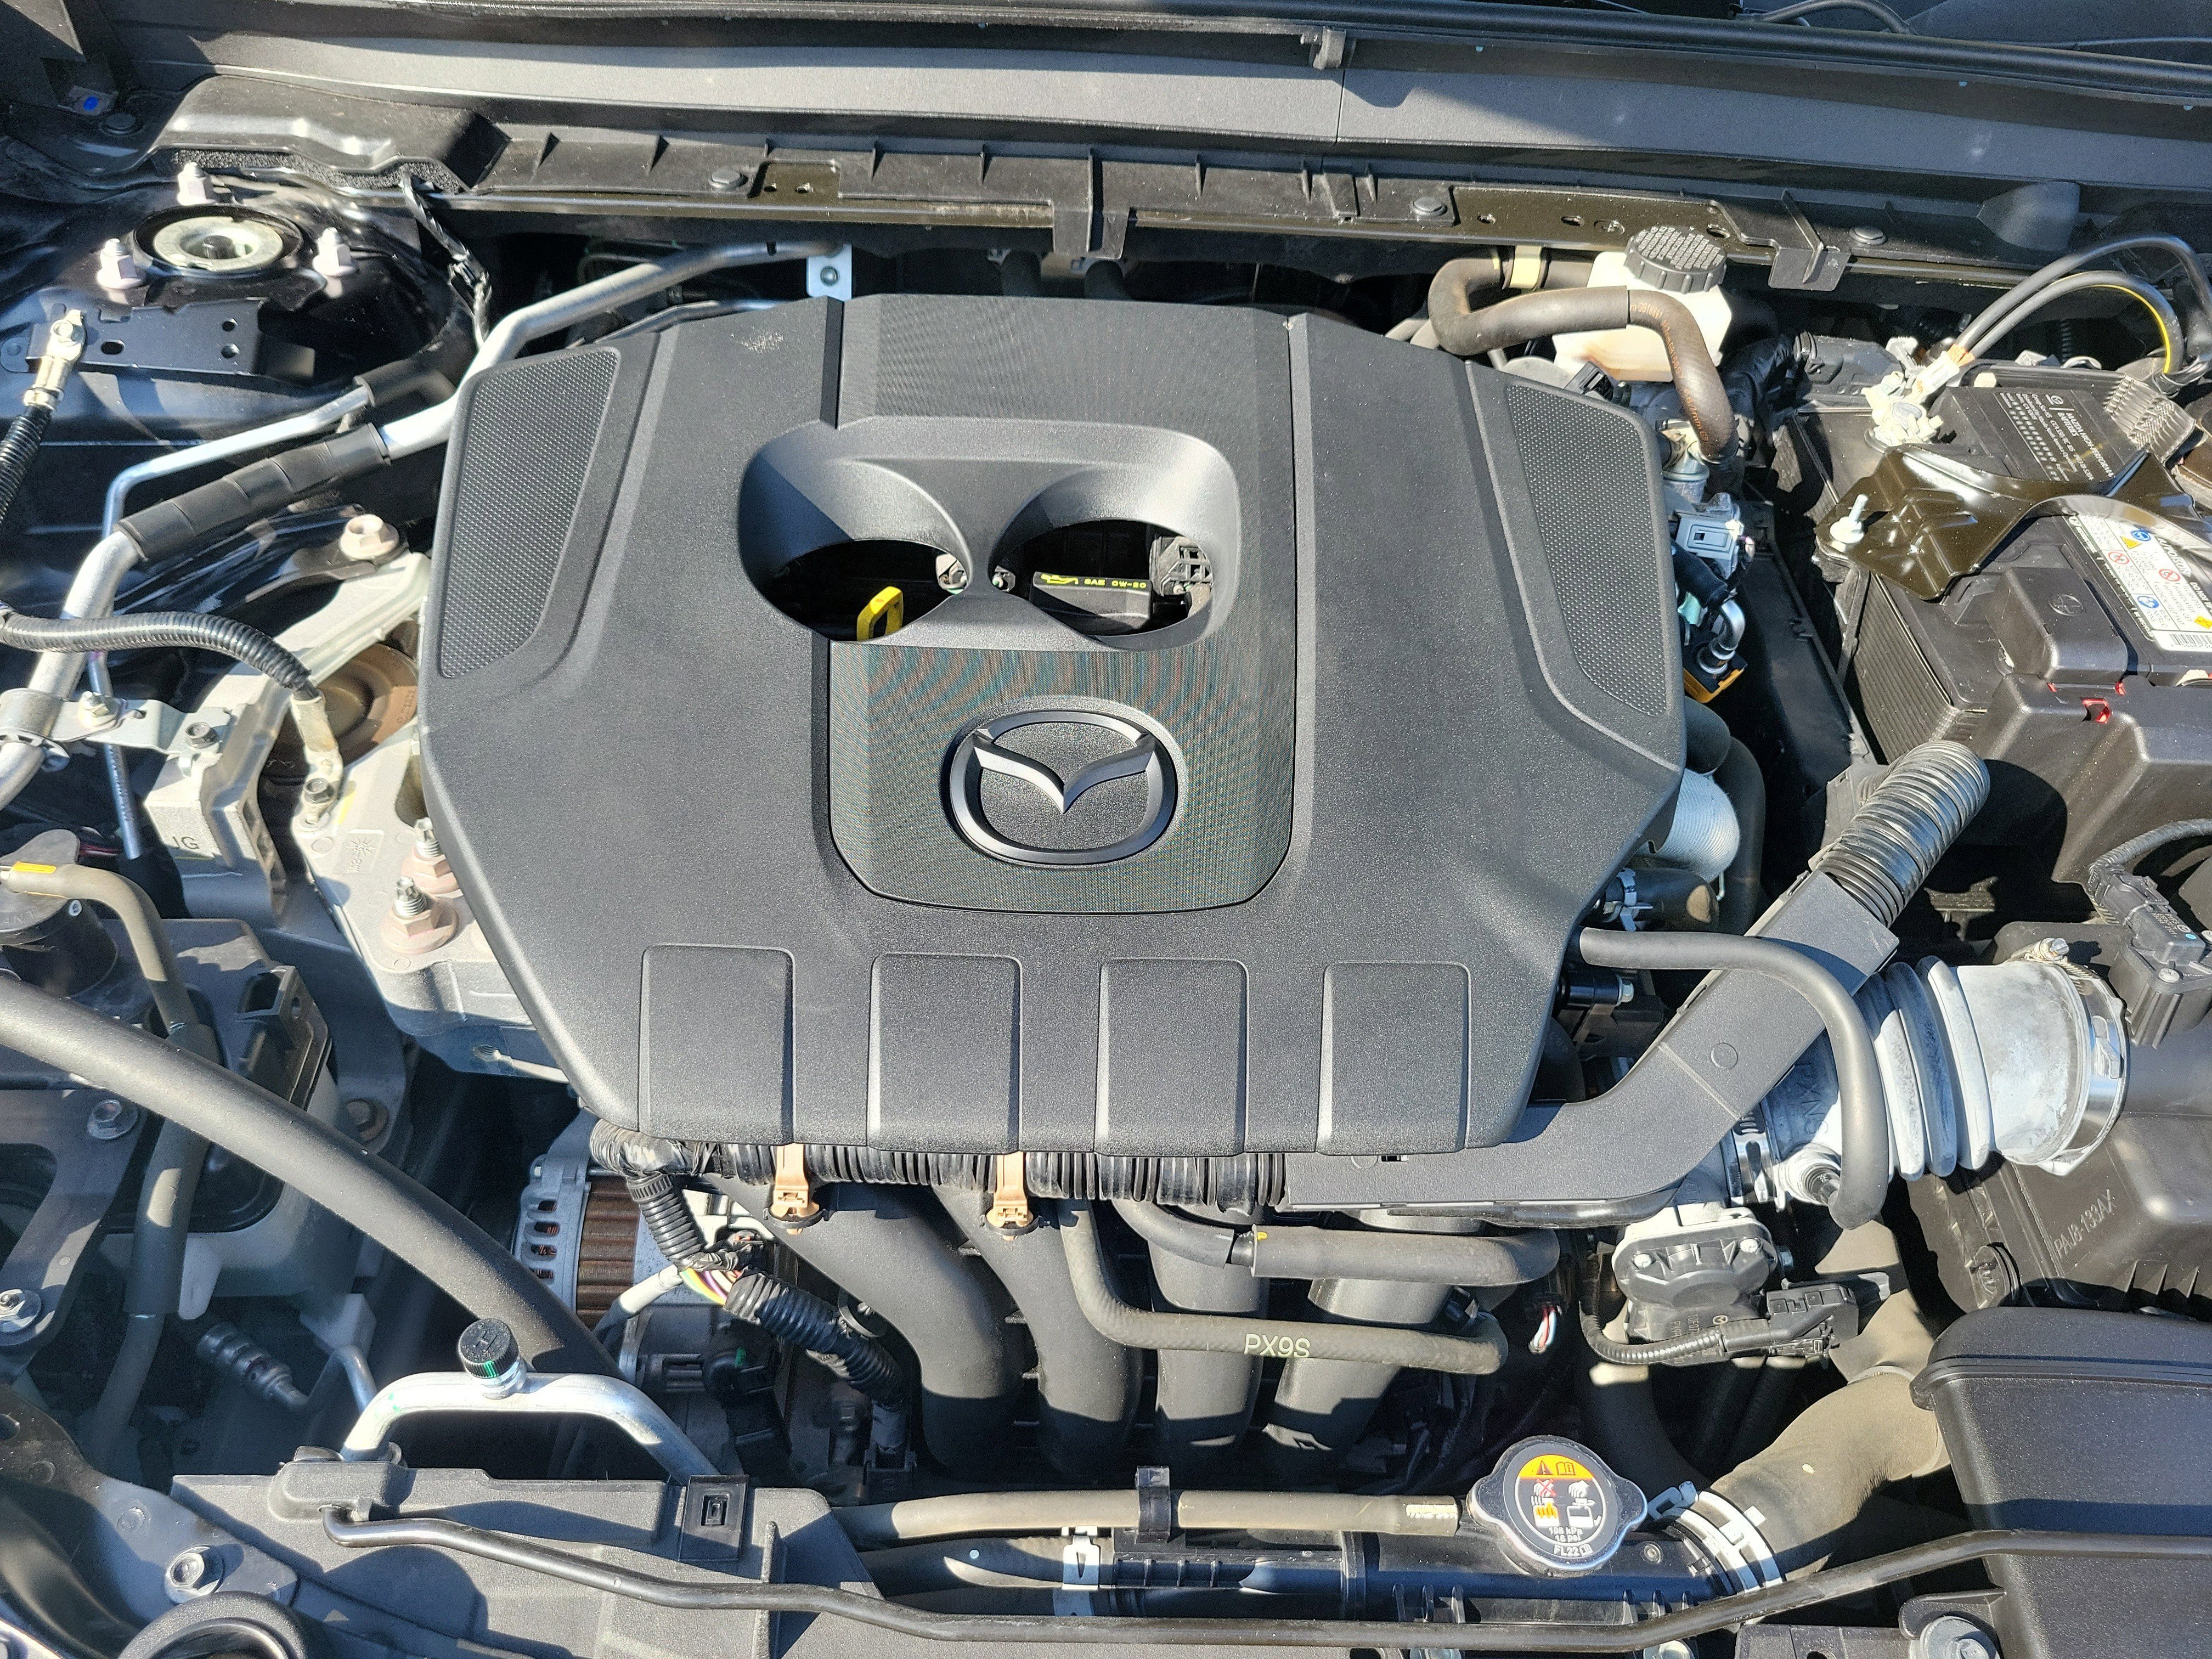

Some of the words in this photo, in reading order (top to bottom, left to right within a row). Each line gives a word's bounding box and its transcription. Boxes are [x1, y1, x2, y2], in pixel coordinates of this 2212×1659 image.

[1084, 578, 1105, 586] SAE
[1111, 580, 1147, 589] 0W-20
[2053, 1188, 2117, 1259] PAJ8-133AX
[1243, 1333, 1311, 1358] PX9S
[1548, 1526, 1565, 1535] 108
[1565, 1526, 1584, 1537] kPa
[1554, 1534, 1567, 1543] 16
[1567, 1534, 1583, 1543] psi
[1553, 1544, 1580, 1556] FL22
